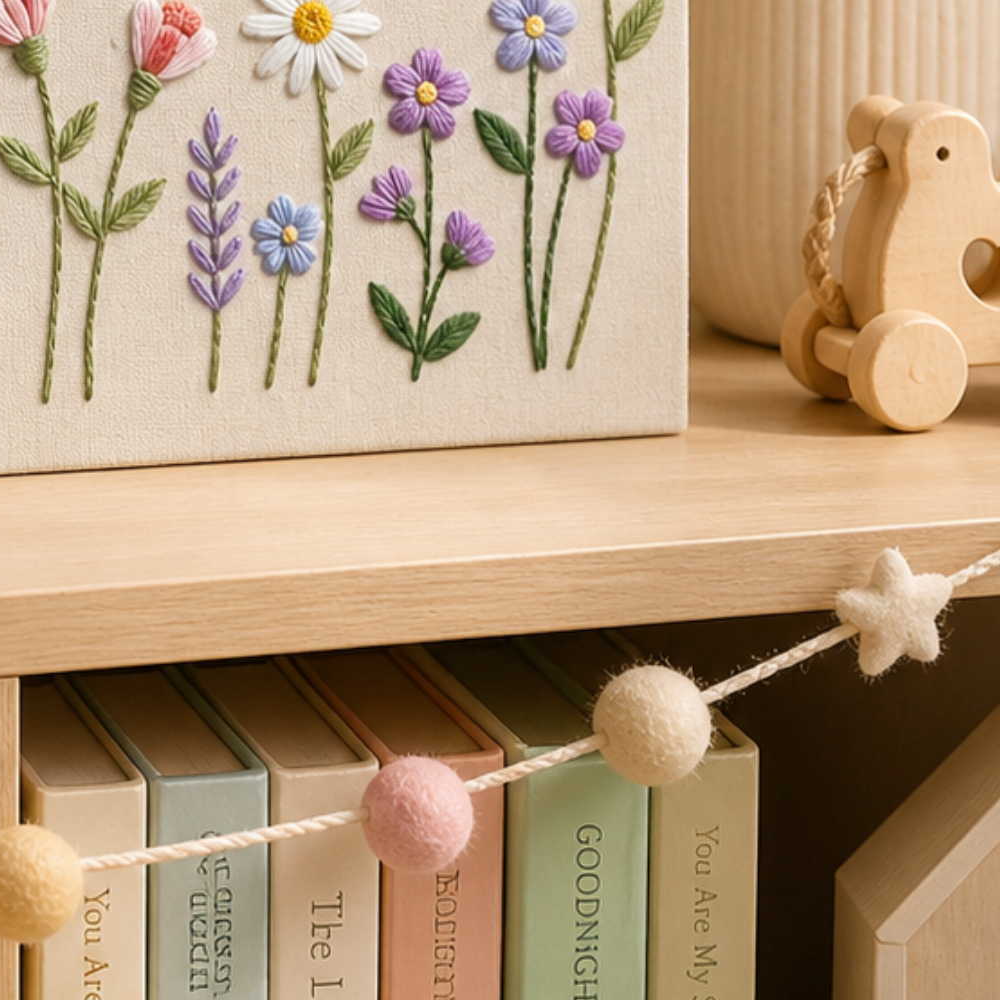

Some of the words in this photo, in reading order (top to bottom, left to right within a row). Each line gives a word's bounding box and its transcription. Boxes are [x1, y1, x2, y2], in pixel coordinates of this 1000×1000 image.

[694, 825, 719, 876] You
[83, 888, 110, 946] You
[693, 887, 717, 934] Are
[686, 943, 718, 986] My
